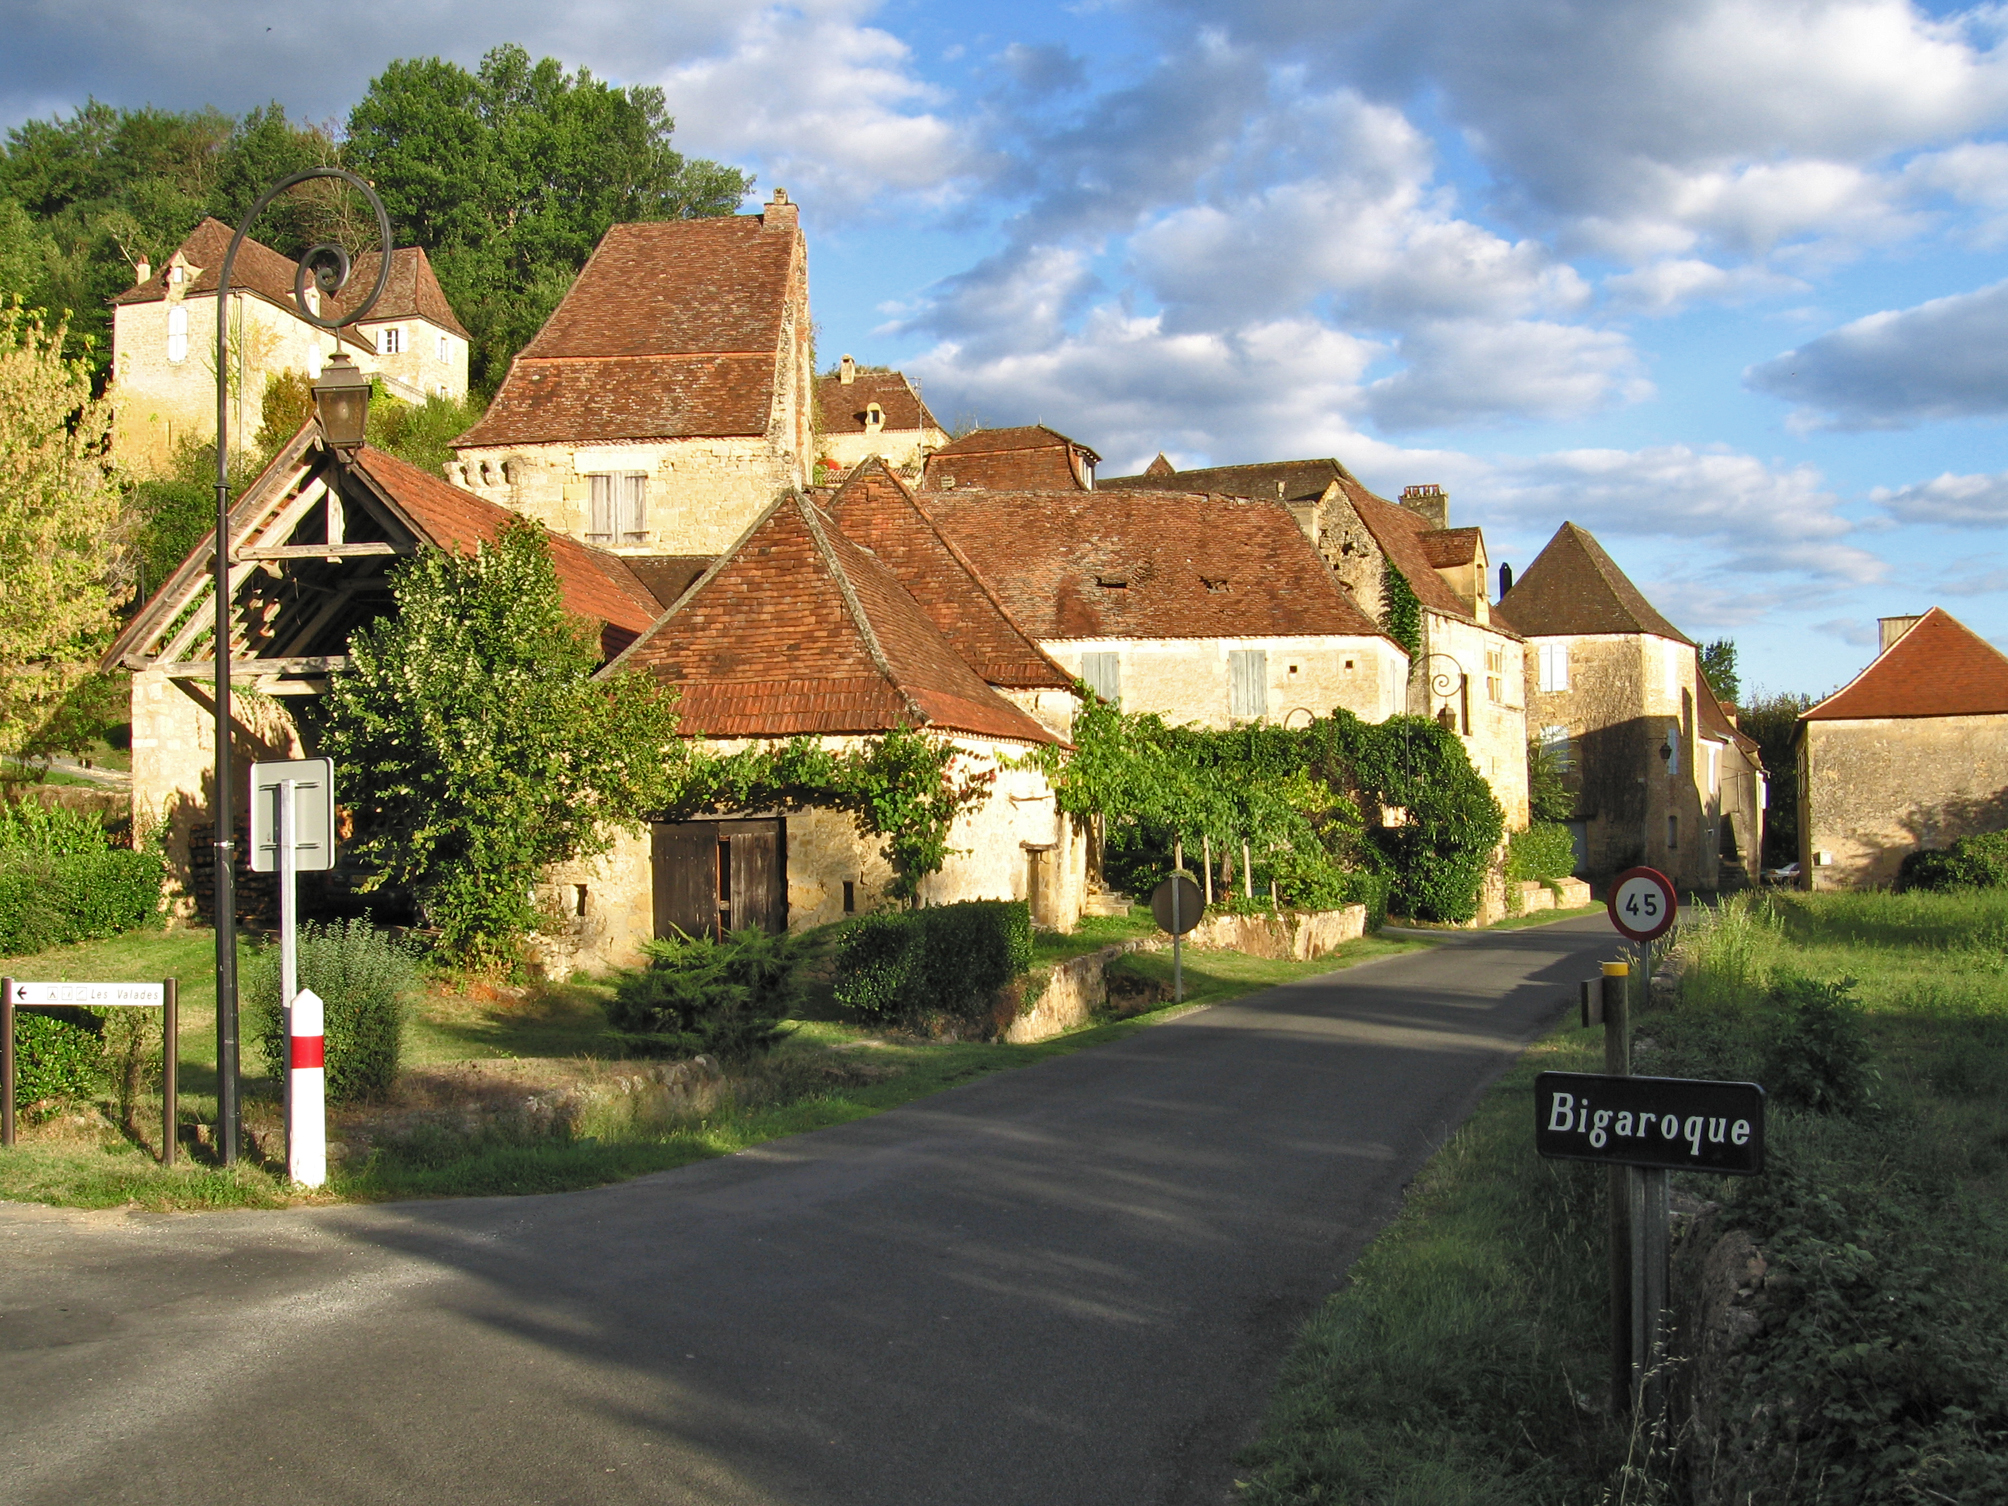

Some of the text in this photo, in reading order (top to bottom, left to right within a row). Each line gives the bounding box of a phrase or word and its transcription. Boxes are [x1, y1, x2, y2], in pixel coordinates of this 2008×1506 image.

[1625, 893, 1657, 916] 45
[91, 989, 159, 1000] Les Valades
[1547, 1092, 1751, 1156] Bigaroque
